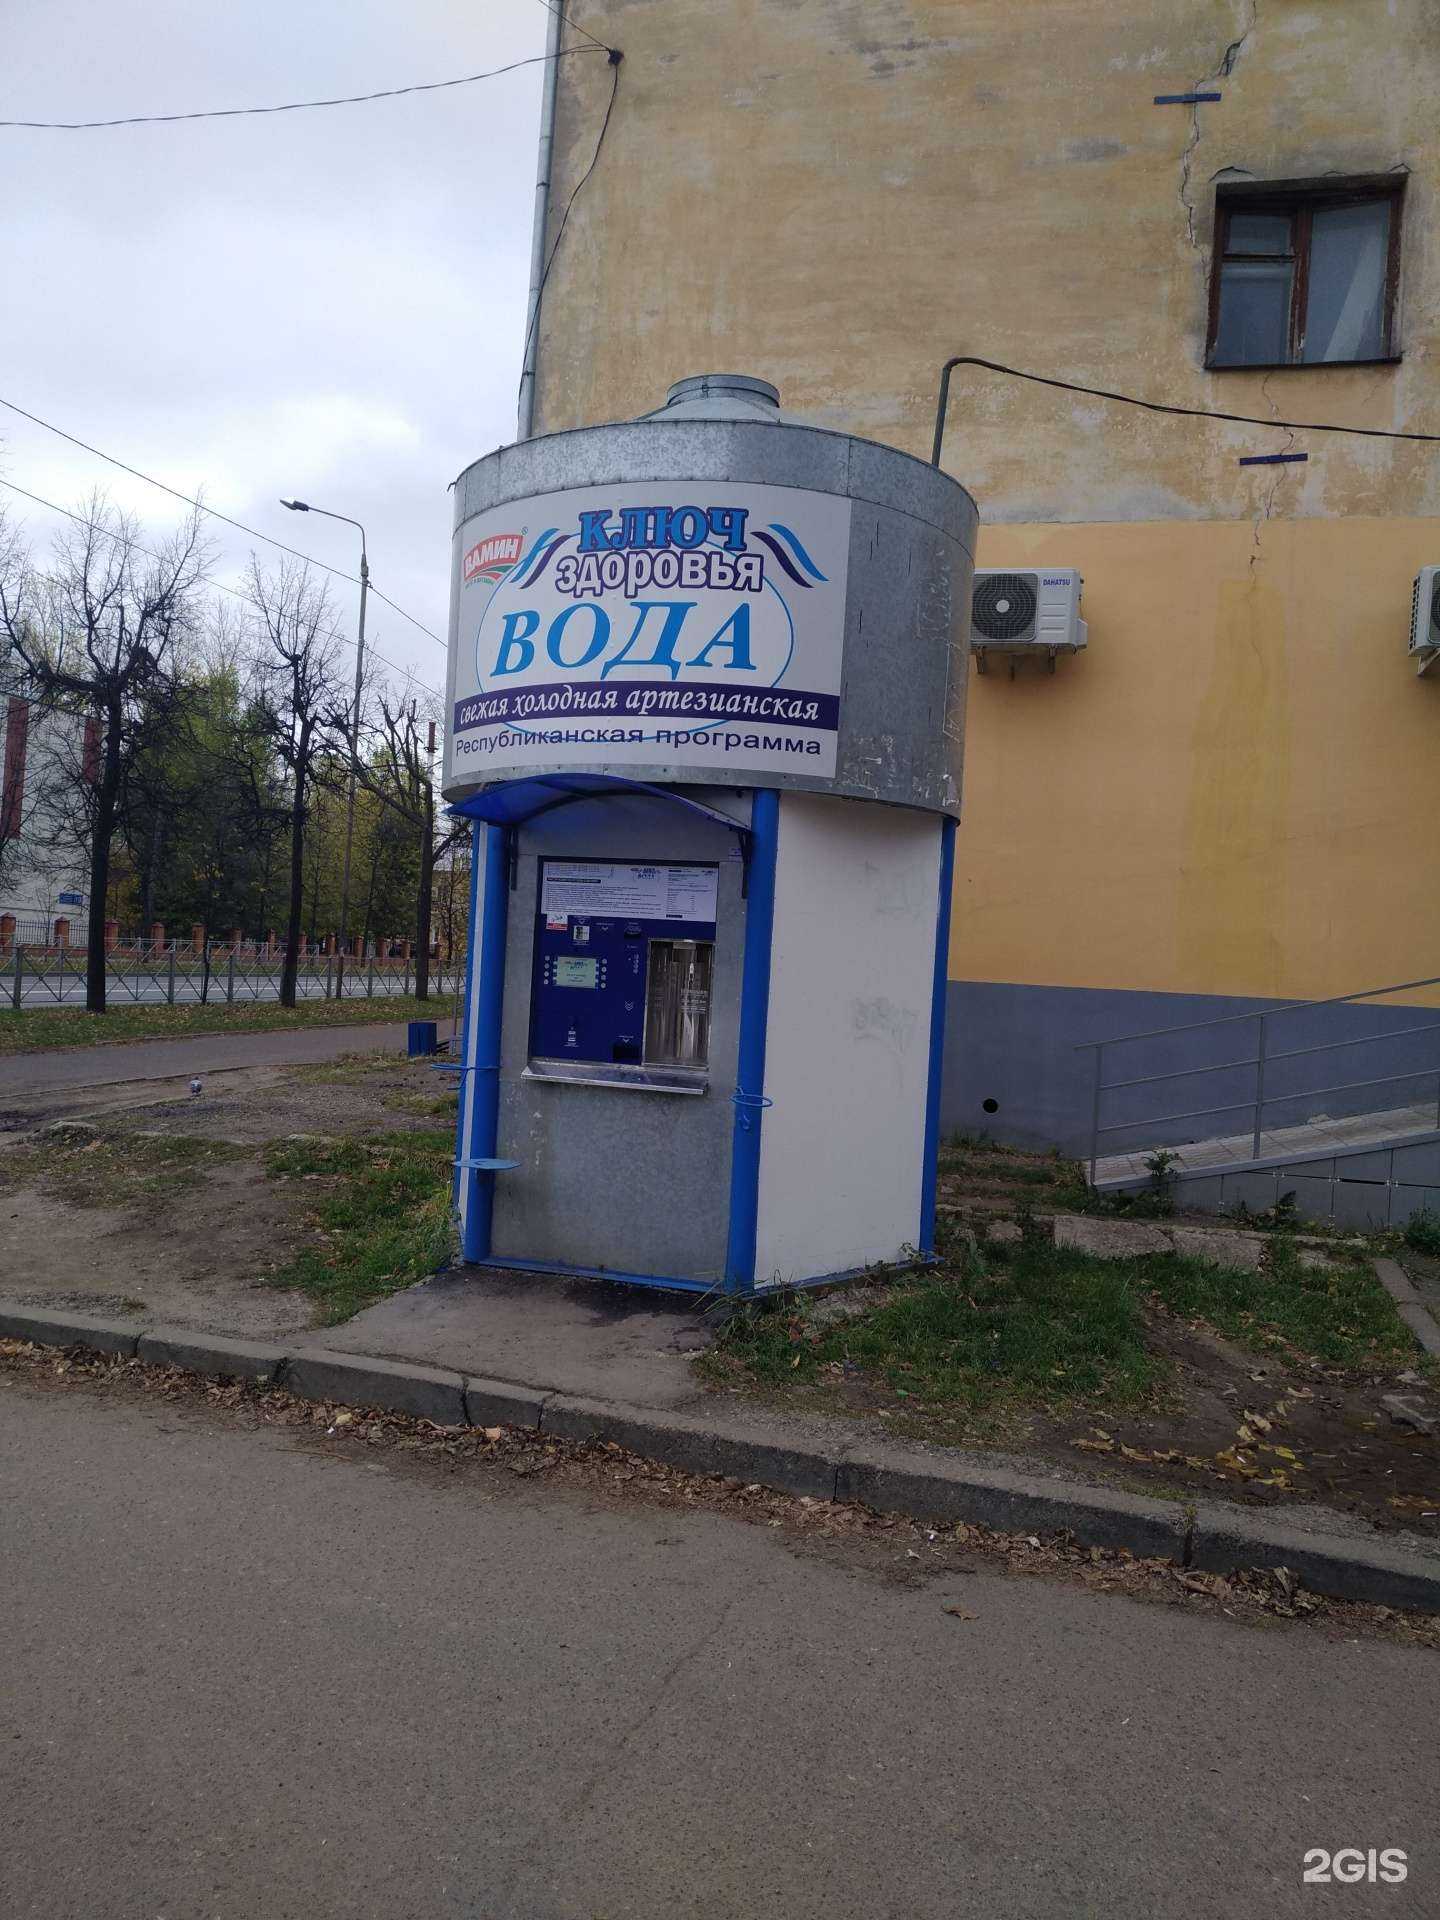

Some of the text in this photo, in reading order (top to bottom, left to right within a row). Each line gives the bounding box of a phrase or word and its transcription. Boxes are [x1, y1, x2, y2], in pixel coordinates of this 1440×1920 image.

[577, 505, 749, 553] КЛЮЧ
[464, 537, 519, 577] ВАМИН
[490, 601, 758, 680] ВОДА
[460, 685, 819, 725] свежая холодная артезианская
[456, 729, 821, 756] Республиканская программа
